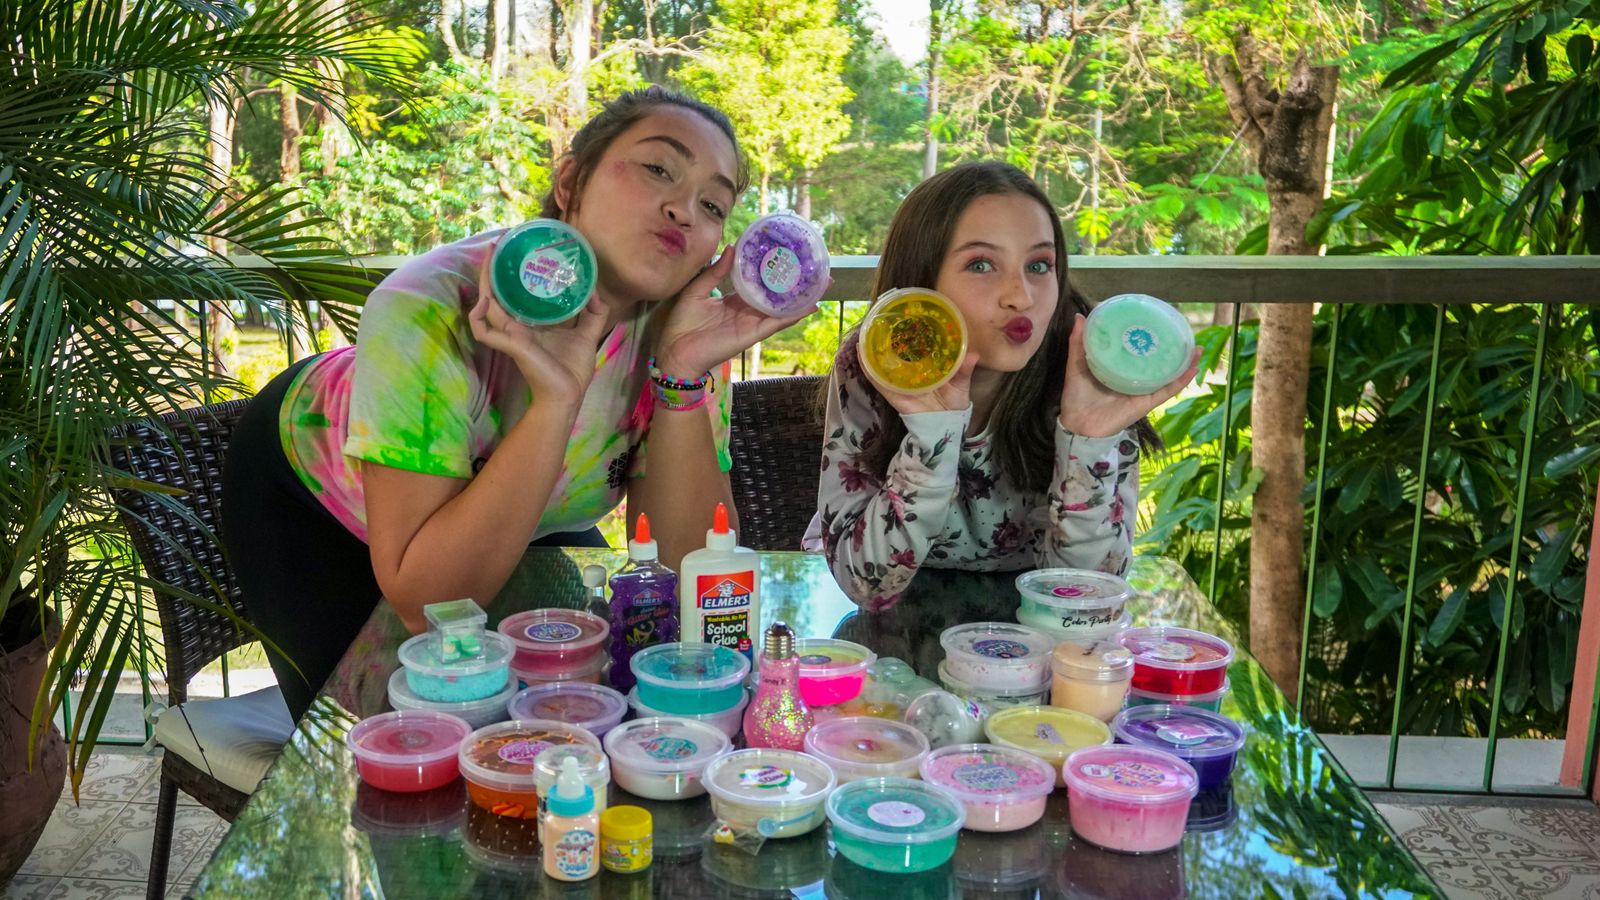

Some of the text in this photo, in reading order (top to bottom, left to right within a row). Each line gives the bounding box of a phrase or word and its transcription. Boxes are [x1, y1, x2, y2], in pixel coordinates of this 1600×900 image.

[704, 594, 749, 608] ELMER'S
[706, 619, 746, 635] School
[1061, 615, 1087, 628] Color
[711, 634, 738, 646] Glue
